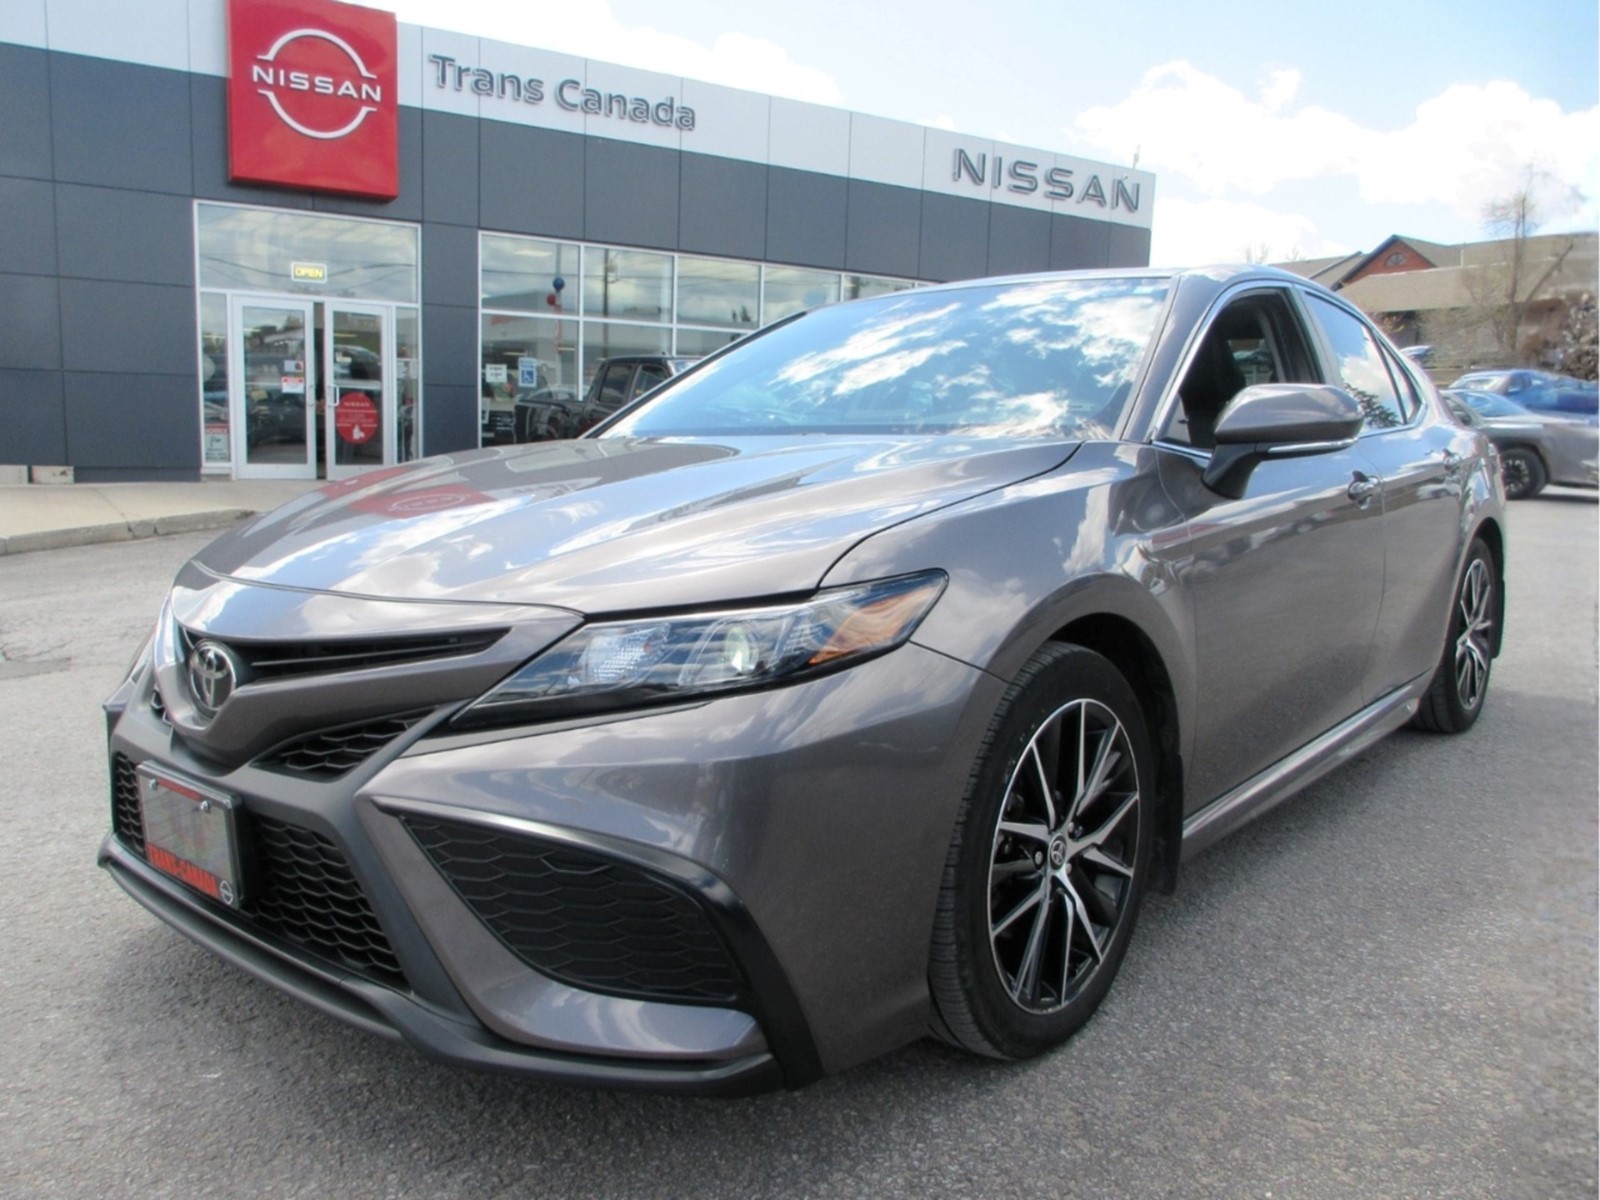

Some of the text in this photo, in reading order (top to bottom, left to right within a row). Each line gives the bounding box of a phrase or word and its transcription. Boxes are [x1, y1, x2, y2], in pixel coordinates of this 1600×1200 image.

[252, 64, 381, 102] NISSAN
[428, 53, 697, 131] Trans Canada
[952, 148, 1140, 213] NISSAN
[295, 267, 323, 278] OPEN
